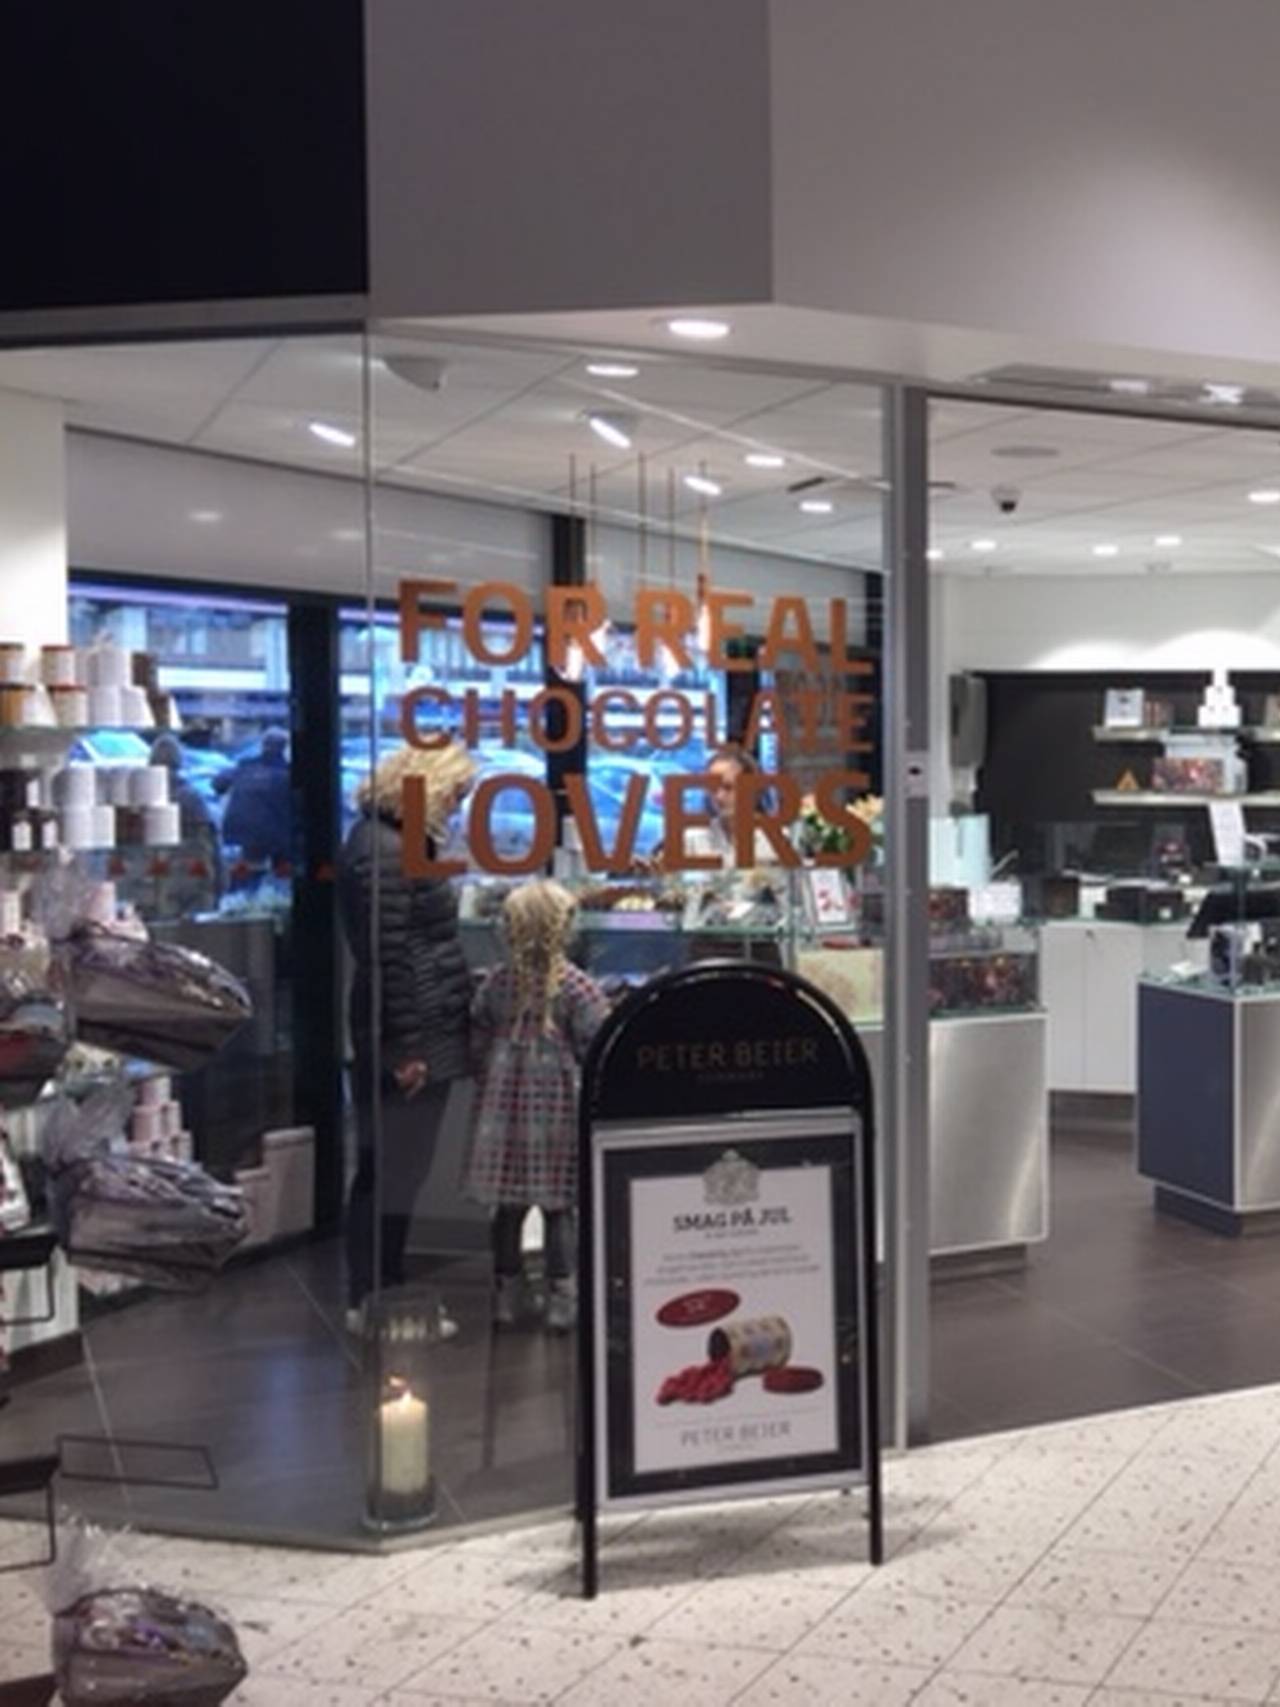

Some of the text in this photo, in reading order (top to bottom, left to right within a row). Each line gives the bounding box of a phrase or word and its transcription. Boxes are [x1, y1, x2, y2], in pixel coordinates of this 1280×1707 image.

[399, 579, 874, 675] FOR REAL
[400, 685, 874, 753] CHOCOLATE
[400, 772, 873, 878] LOVERS
[638, 1037, 819, 1071] PETER BEIER
[673, 1205, 792, 1232] SMAG PÅ JUL
[680, 1419, 792, 1447] PETER BEIER
